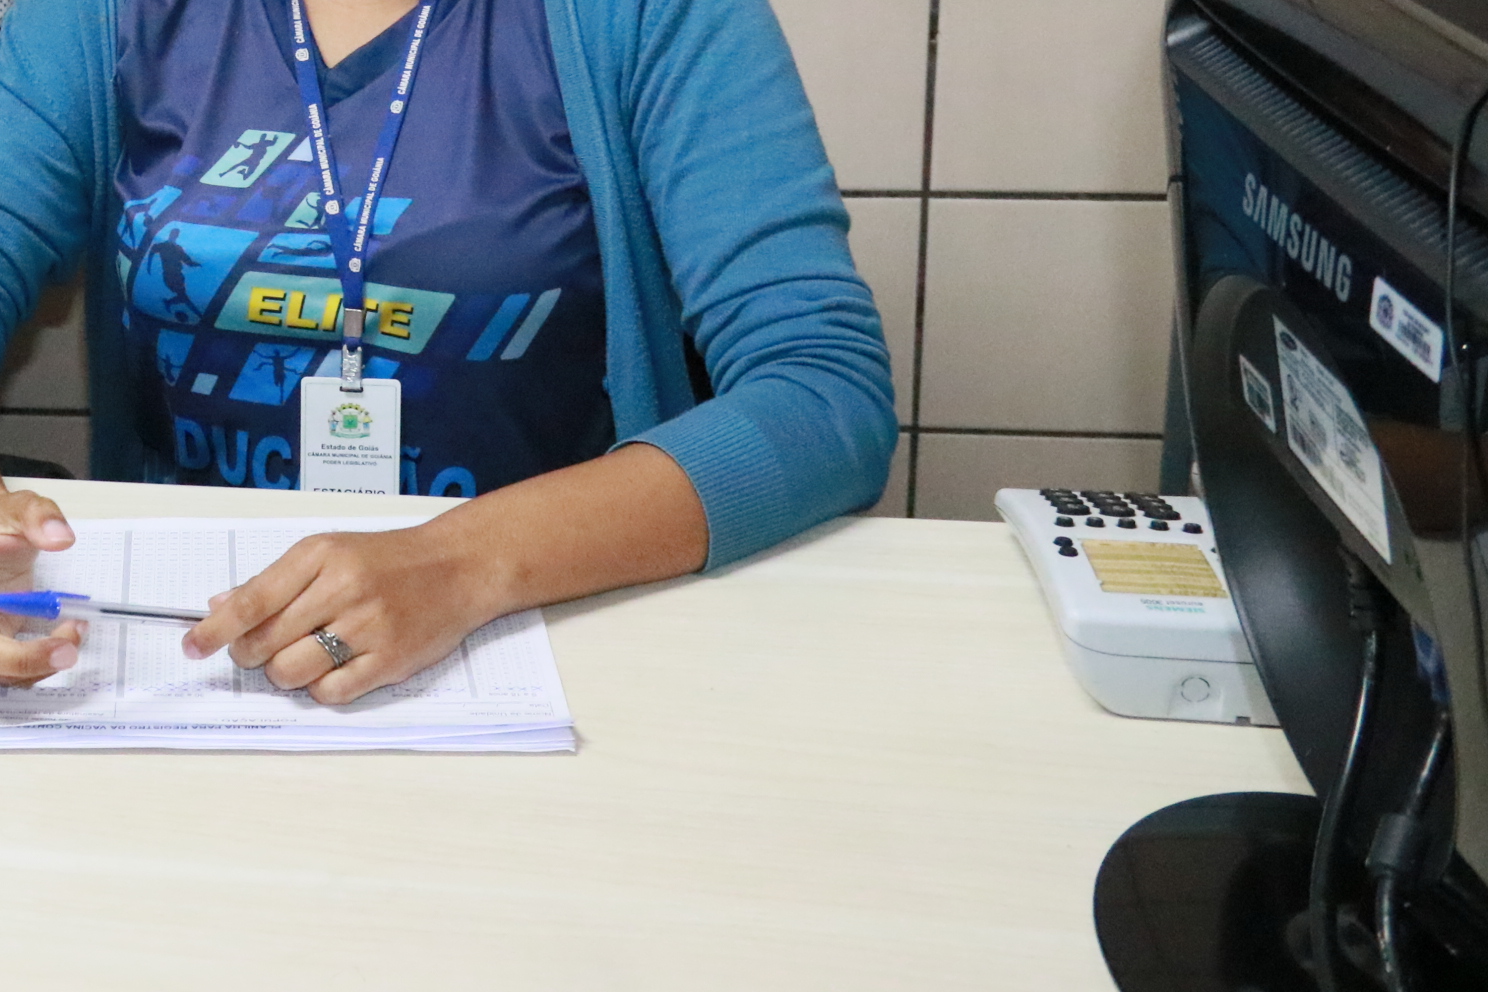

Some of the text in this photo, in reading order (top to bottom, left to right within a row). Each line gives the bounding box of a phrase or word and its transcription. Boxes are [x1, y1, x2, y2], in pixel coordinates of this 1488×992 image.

[397, 5, 431, 95] CÂMARA MUNICIPAL DE GOIÂNIA
[308, 103, 335, 196] CÂMARA MUNICIPAL DE GOIÂNIA
[353, 157, 385, 252] CÂMARA MUNICIPAL DE GOIÂNIA
[1241, 172, 1353, 303] SAMSUNG
[320, 443, 346, 451] Estado
[358, 444, 379, 452] Goiás
[1145, 605, 1206, 614] SIEMENS
